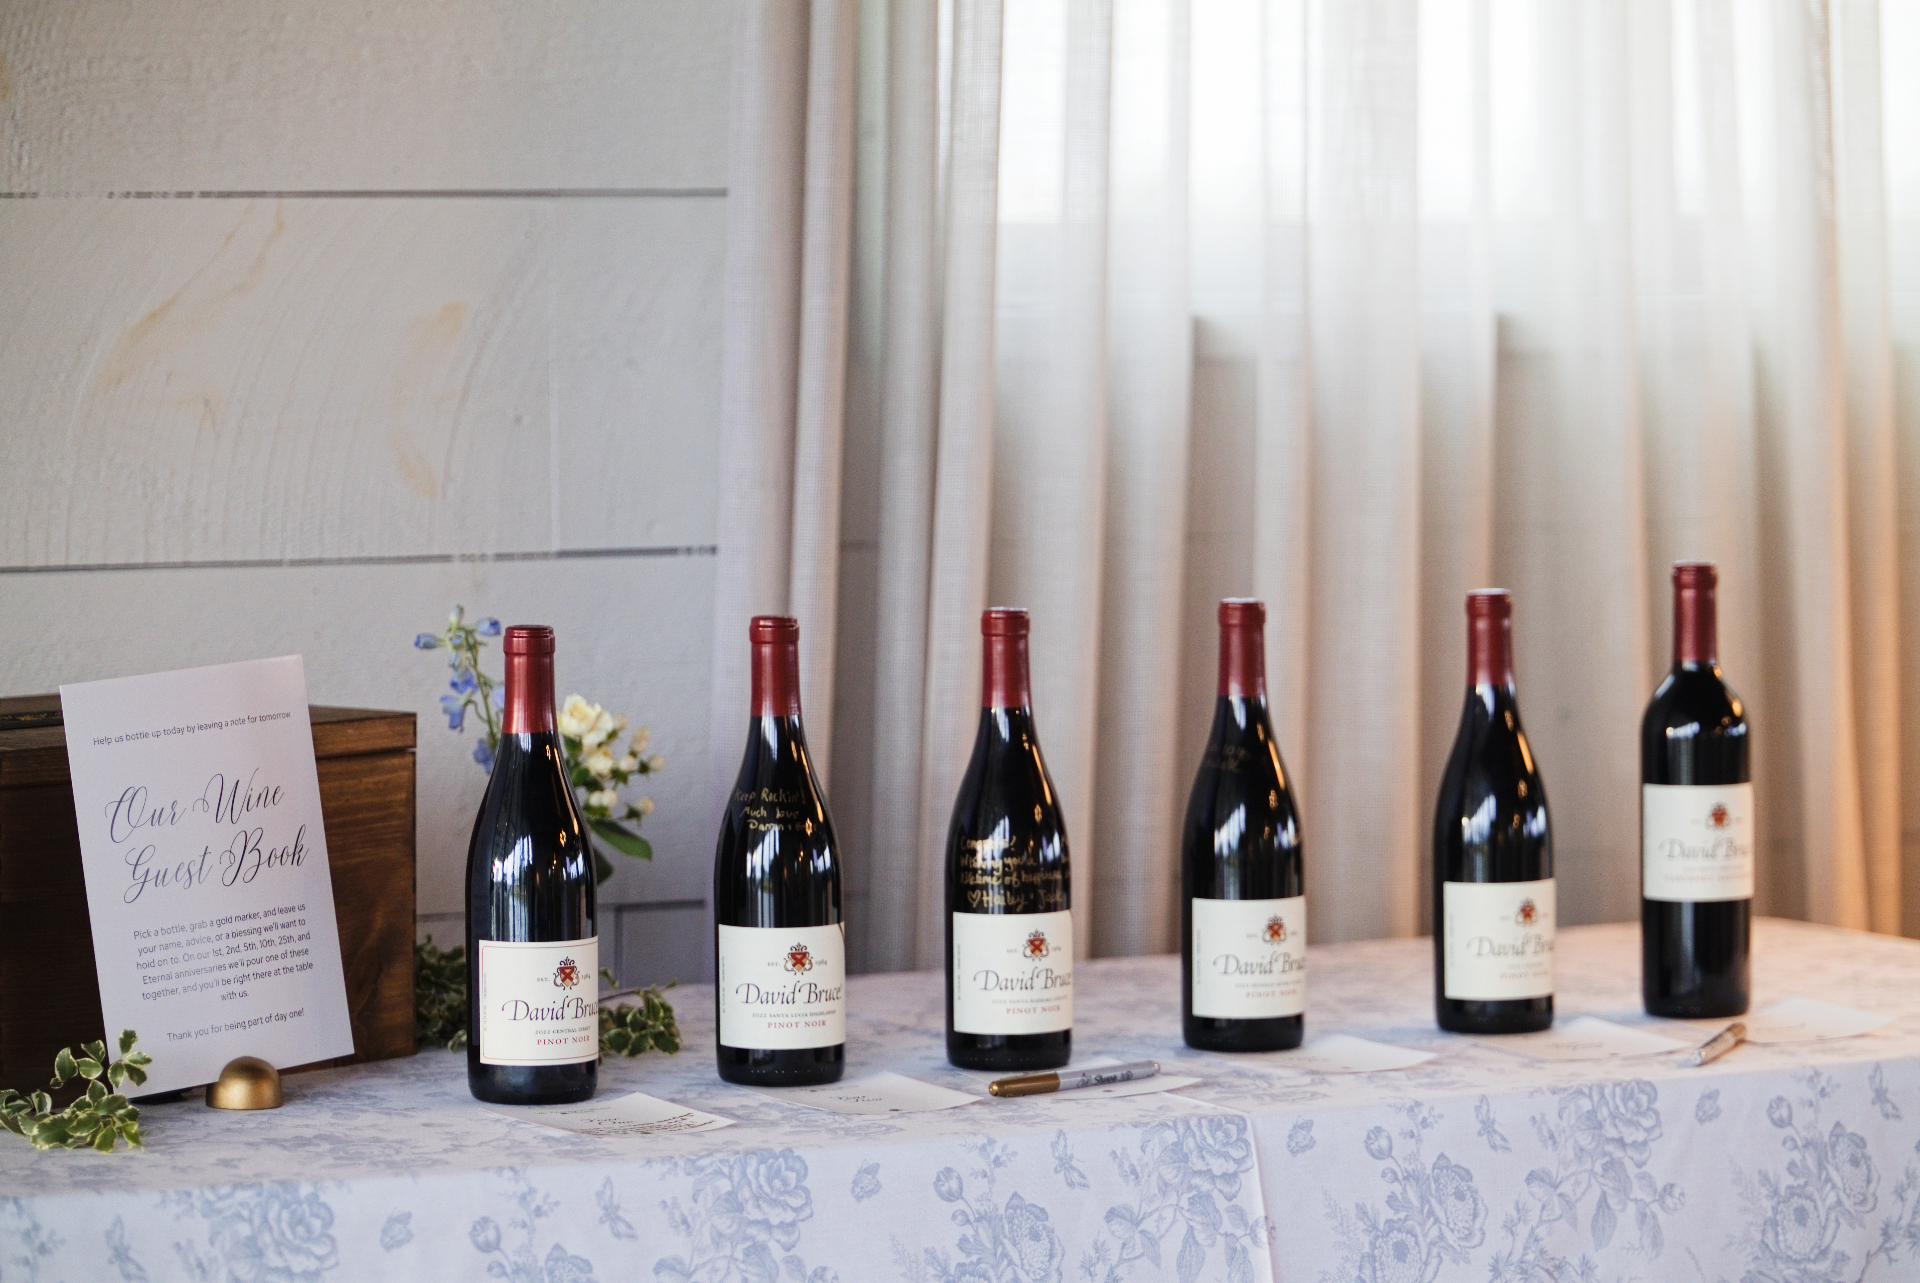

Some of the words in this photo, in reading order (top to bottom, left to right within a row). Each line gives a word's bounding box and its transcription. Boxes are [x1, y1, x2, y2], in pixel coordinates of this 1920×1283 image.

[93, 737, 113, 746] Help
[125, 731, 150, 741] bottle
[151, 730, 162, 739] up
[163, 726, 185, 736] today
[186, 725, 196, 733] by
[197, 720, 223, 731] leaving
[230, 717, 246, 726] note
[247, 715, 257, 723] for
[259, 711, 291, 722] tomorrow
[105, 786, 186, 843] Our
[193, 767, 284, 824] Wine
[739, 806, 767, 818] Much
[124, 845, 213, 903] Guest
[220, 824, 309, 886] Book
[133, 929, 152, 940] Pick
[153, 929, 159, 937] a
[161, 924, 187, 935] bottle,
[189, 920, 208, 932] grab
[215, 916, 233, 928] gold
[234, 912, 262, 922] marker,
[263, 907, 276, 917] and
[278, 905, 296, 915] leave
[297, 903, 306, 911] us
[136, 958, 155, 970] hold
[157, 958, 168, 967] on
[182, 953, 195, 962] On
[196, 951, 210, 960] our
[212, 947, 224, 957] 1st,
[243, 941, 259, 951] 5th,
[278, 935, 297, 945] 25th,
[297, 931, 311, 941] and
[138, 945, 156, 957] your
[159, 941, 184, 951] name,
[185, 936, 213, 947] advice,
[225, 932, 230, 940] a
[231, 926, 262, 938] blessing
[263, 922, 279, 932] we'll
[280, 919, 297, 929] want
[298, 918, 306, 926] to
[142, 971, 173, 985] Eternal
[174, 963, 226, 979] anniversaries
[228, 958, 245, 969] we'll
[246, 956, 263, 968] pour
[265, 954, 279, 962] one
[281, 949, 288, 959] of
[290, 948, 309, 958] these
[1213, 950, 1277, 974] David
[142, 988, 180, 1001] together,
[182, 982, 197, 993] and
[199, 979, 220, 992] you'll
[221, 978, 232, 986] be
[233, 973, 250, 985] right
[253, 970, 272, 980] there
[273, 968, 281, 976] at
[282, 965, 294, 974] the
[296, 961, 314, 972] table
[735, 980, 800, 1005] David
[798, 982, 841, 1003] Bruce
[973, 966, 1038, 991] David
[221, 990, 237, 1001] with
[501, 995, 569, 1021] David
[1006, 1006, 1038, 1014] PINOT
[1041, 1005, 1061, 1013] NOIR
[166, 1031, 192, 1041] Thank
[194, 1027, 209, 1039] you
[210, 1024, 222, 1033] for
[224, 1020, 247, 1031] being
[248, 1016, 263, 1028] part
[264, 1014, 273, 1023] of
[274, 1012, 287, 1022] day
[288, 1007, 304, 1018] one!
[767, 1021, 800, 1029] PINOT
[804, 1020, 826, 1028] NOIR
[572, 1035, 590, 1044] NOIR
